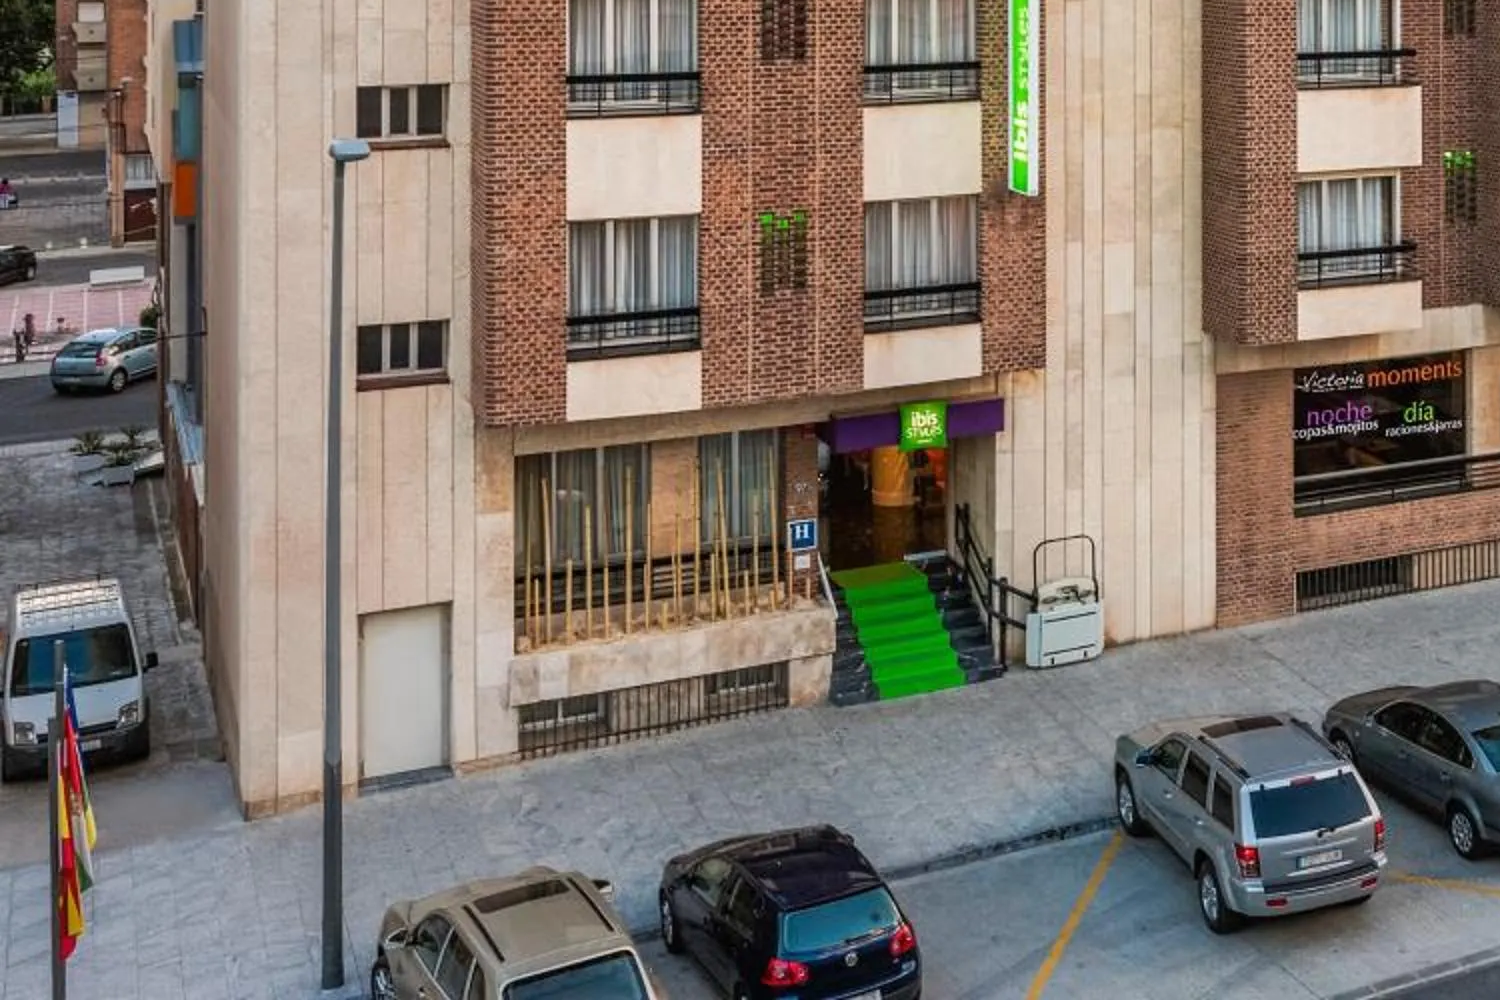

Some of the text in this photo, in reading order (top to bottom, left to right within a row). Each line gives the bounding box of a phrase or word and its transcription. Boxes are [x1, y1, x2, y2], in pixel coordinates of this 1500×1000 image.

[1013, 101, 1028, 163] ibis
[1297, 359, 1463, 393] Victoria moments
[911, 410, 938, 427] ibis
[1306, 401, 1373, 426] noche
[1403, 399, 1435, 423] día
[1292, 419, 1379, 441] copas&mojitos
[1385, 419, 1463, 437] raciones&jarras
[795, 524, 809, 539] H
